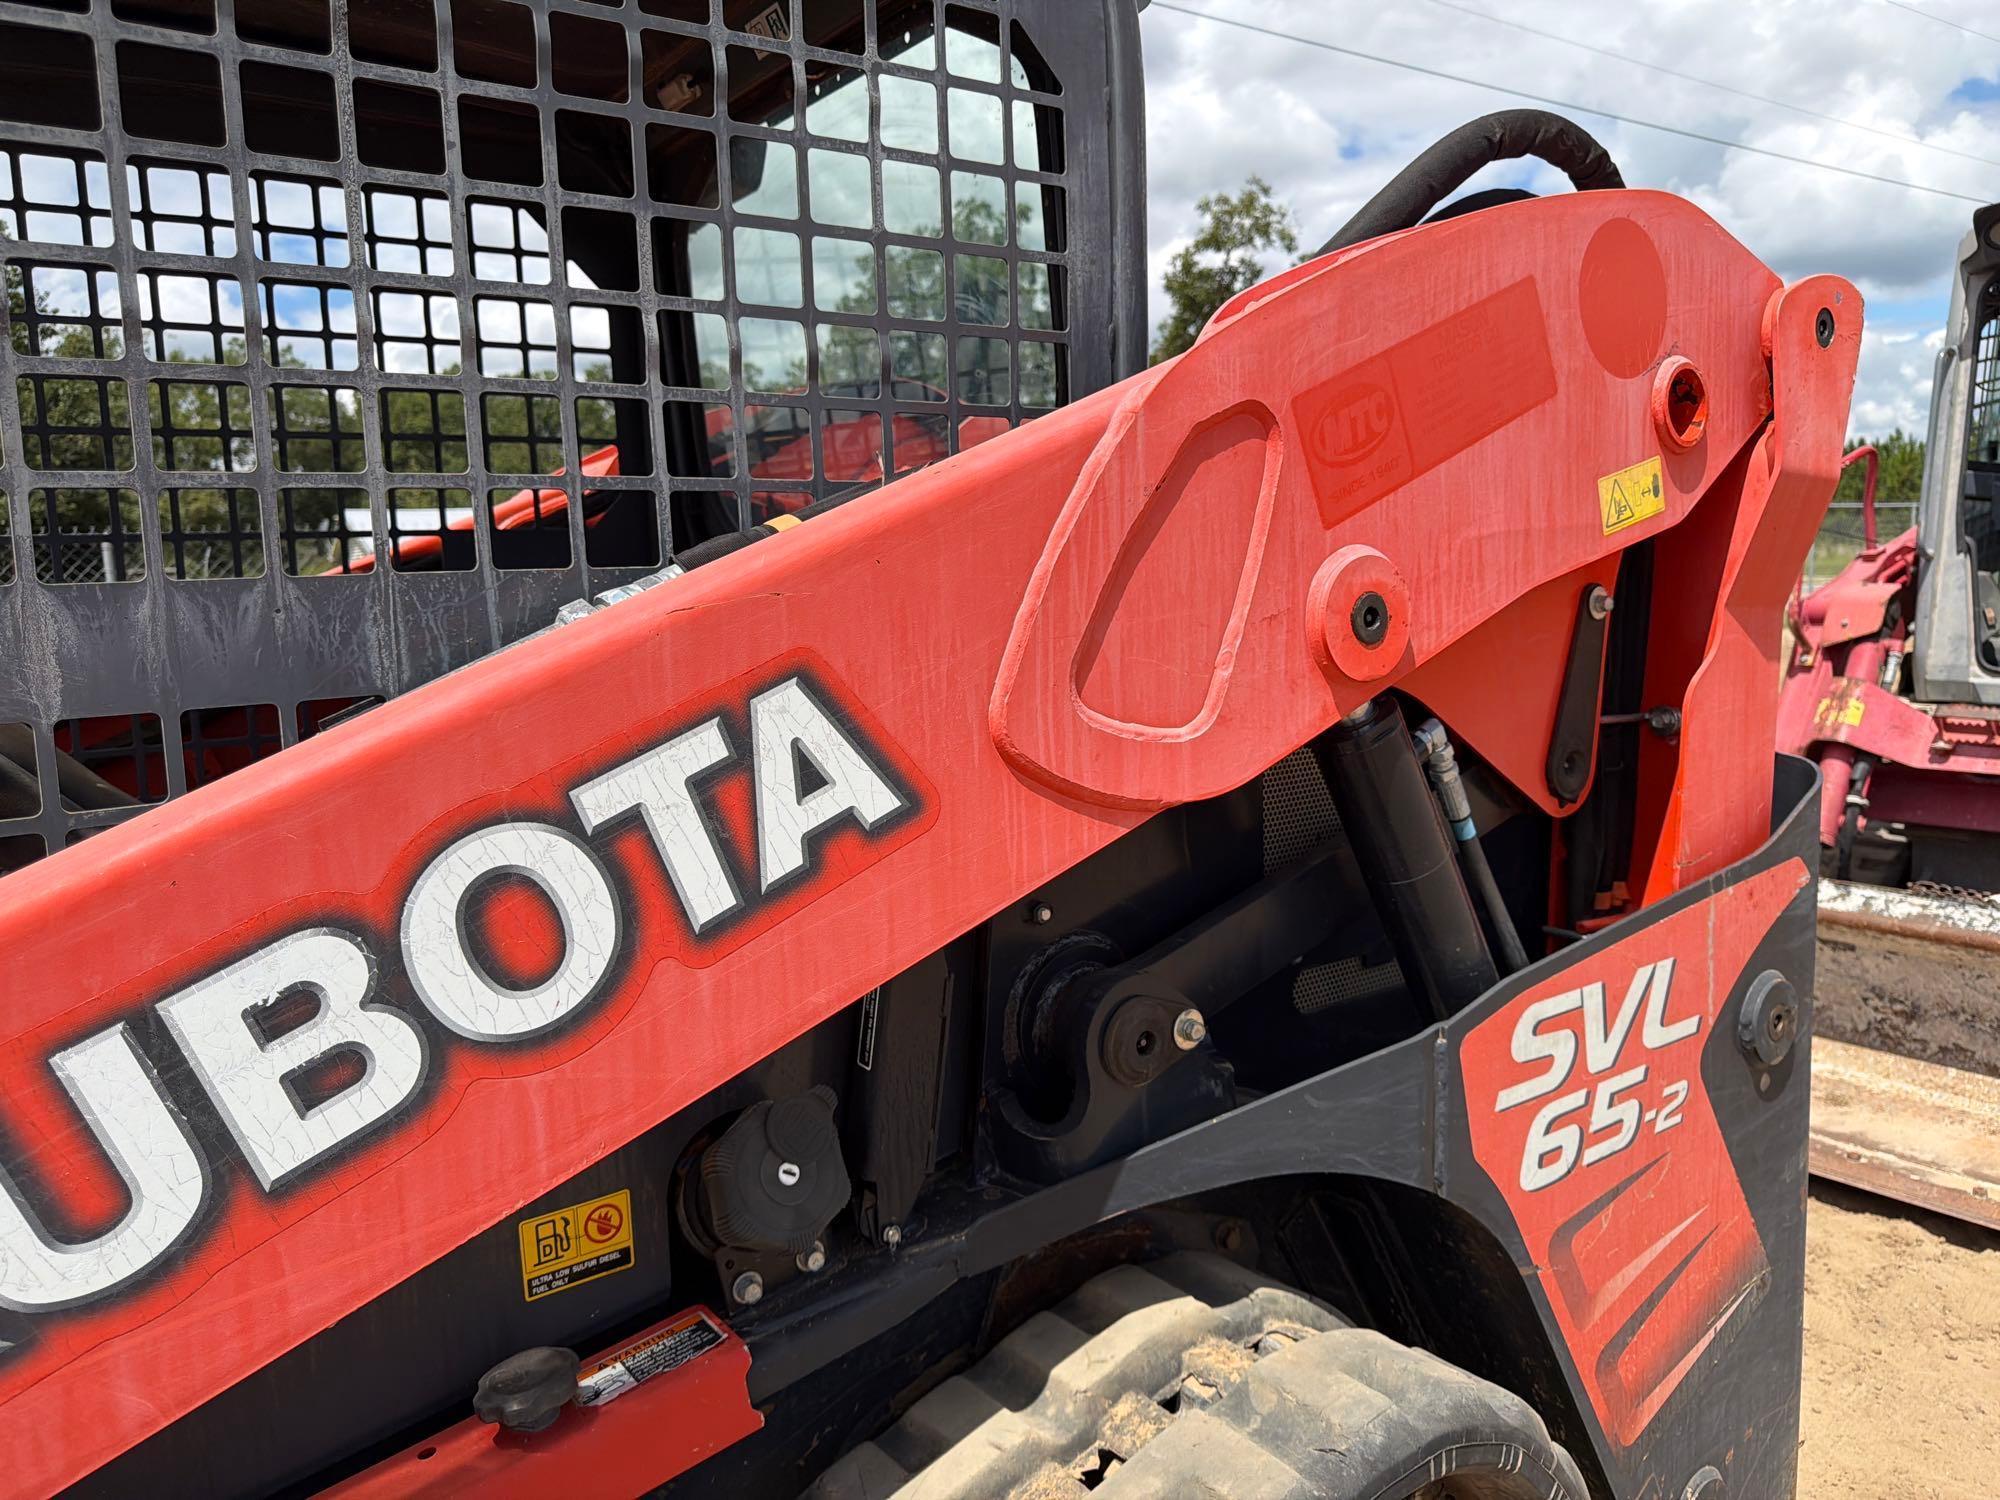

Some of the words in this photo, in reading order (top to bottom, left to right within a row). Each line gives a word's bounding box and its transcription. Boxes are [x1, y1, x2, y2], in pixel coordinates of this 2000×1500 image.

[1319, 390, 1389, 458] MTC
[1330, 474, 1368, 504] SINCE
[0, 677, 909, 1347] UBOTA
[1495, 957, 1702, 1113] SVL
[1519, 1064, 1689, 1192] 65-2
[531, 1273, 554, 1287] ULTRA
[555, 1267, 571, 1278] LOW
[572, 1259, 598, 1272] SULFUR
[599, 1251, 621, 1263] DIESEL
[532, 1284, 550, 1295] FUEL
[551, 1277, 569, 1289] ONLY
[611, 1328, 676, 1362] WARNING
